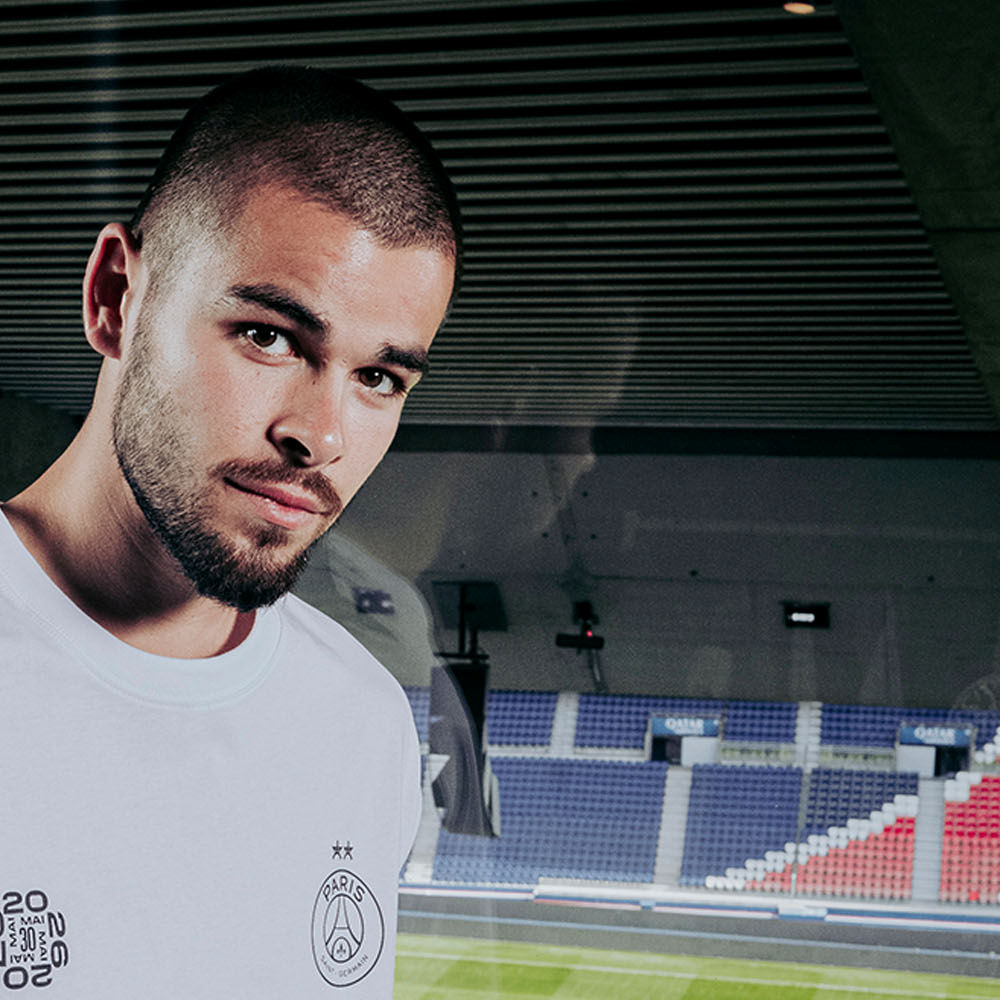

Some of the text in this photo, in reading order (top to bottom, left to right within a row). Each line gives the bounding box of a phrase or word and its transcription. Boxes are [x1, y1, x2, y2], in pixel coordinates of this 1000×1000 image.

[323, 875, 365, 902] PARIS
[2, 890, 48, 915] 20
[20, 915, 45, 925] MAI
[19, 926, 36, 952] 30
